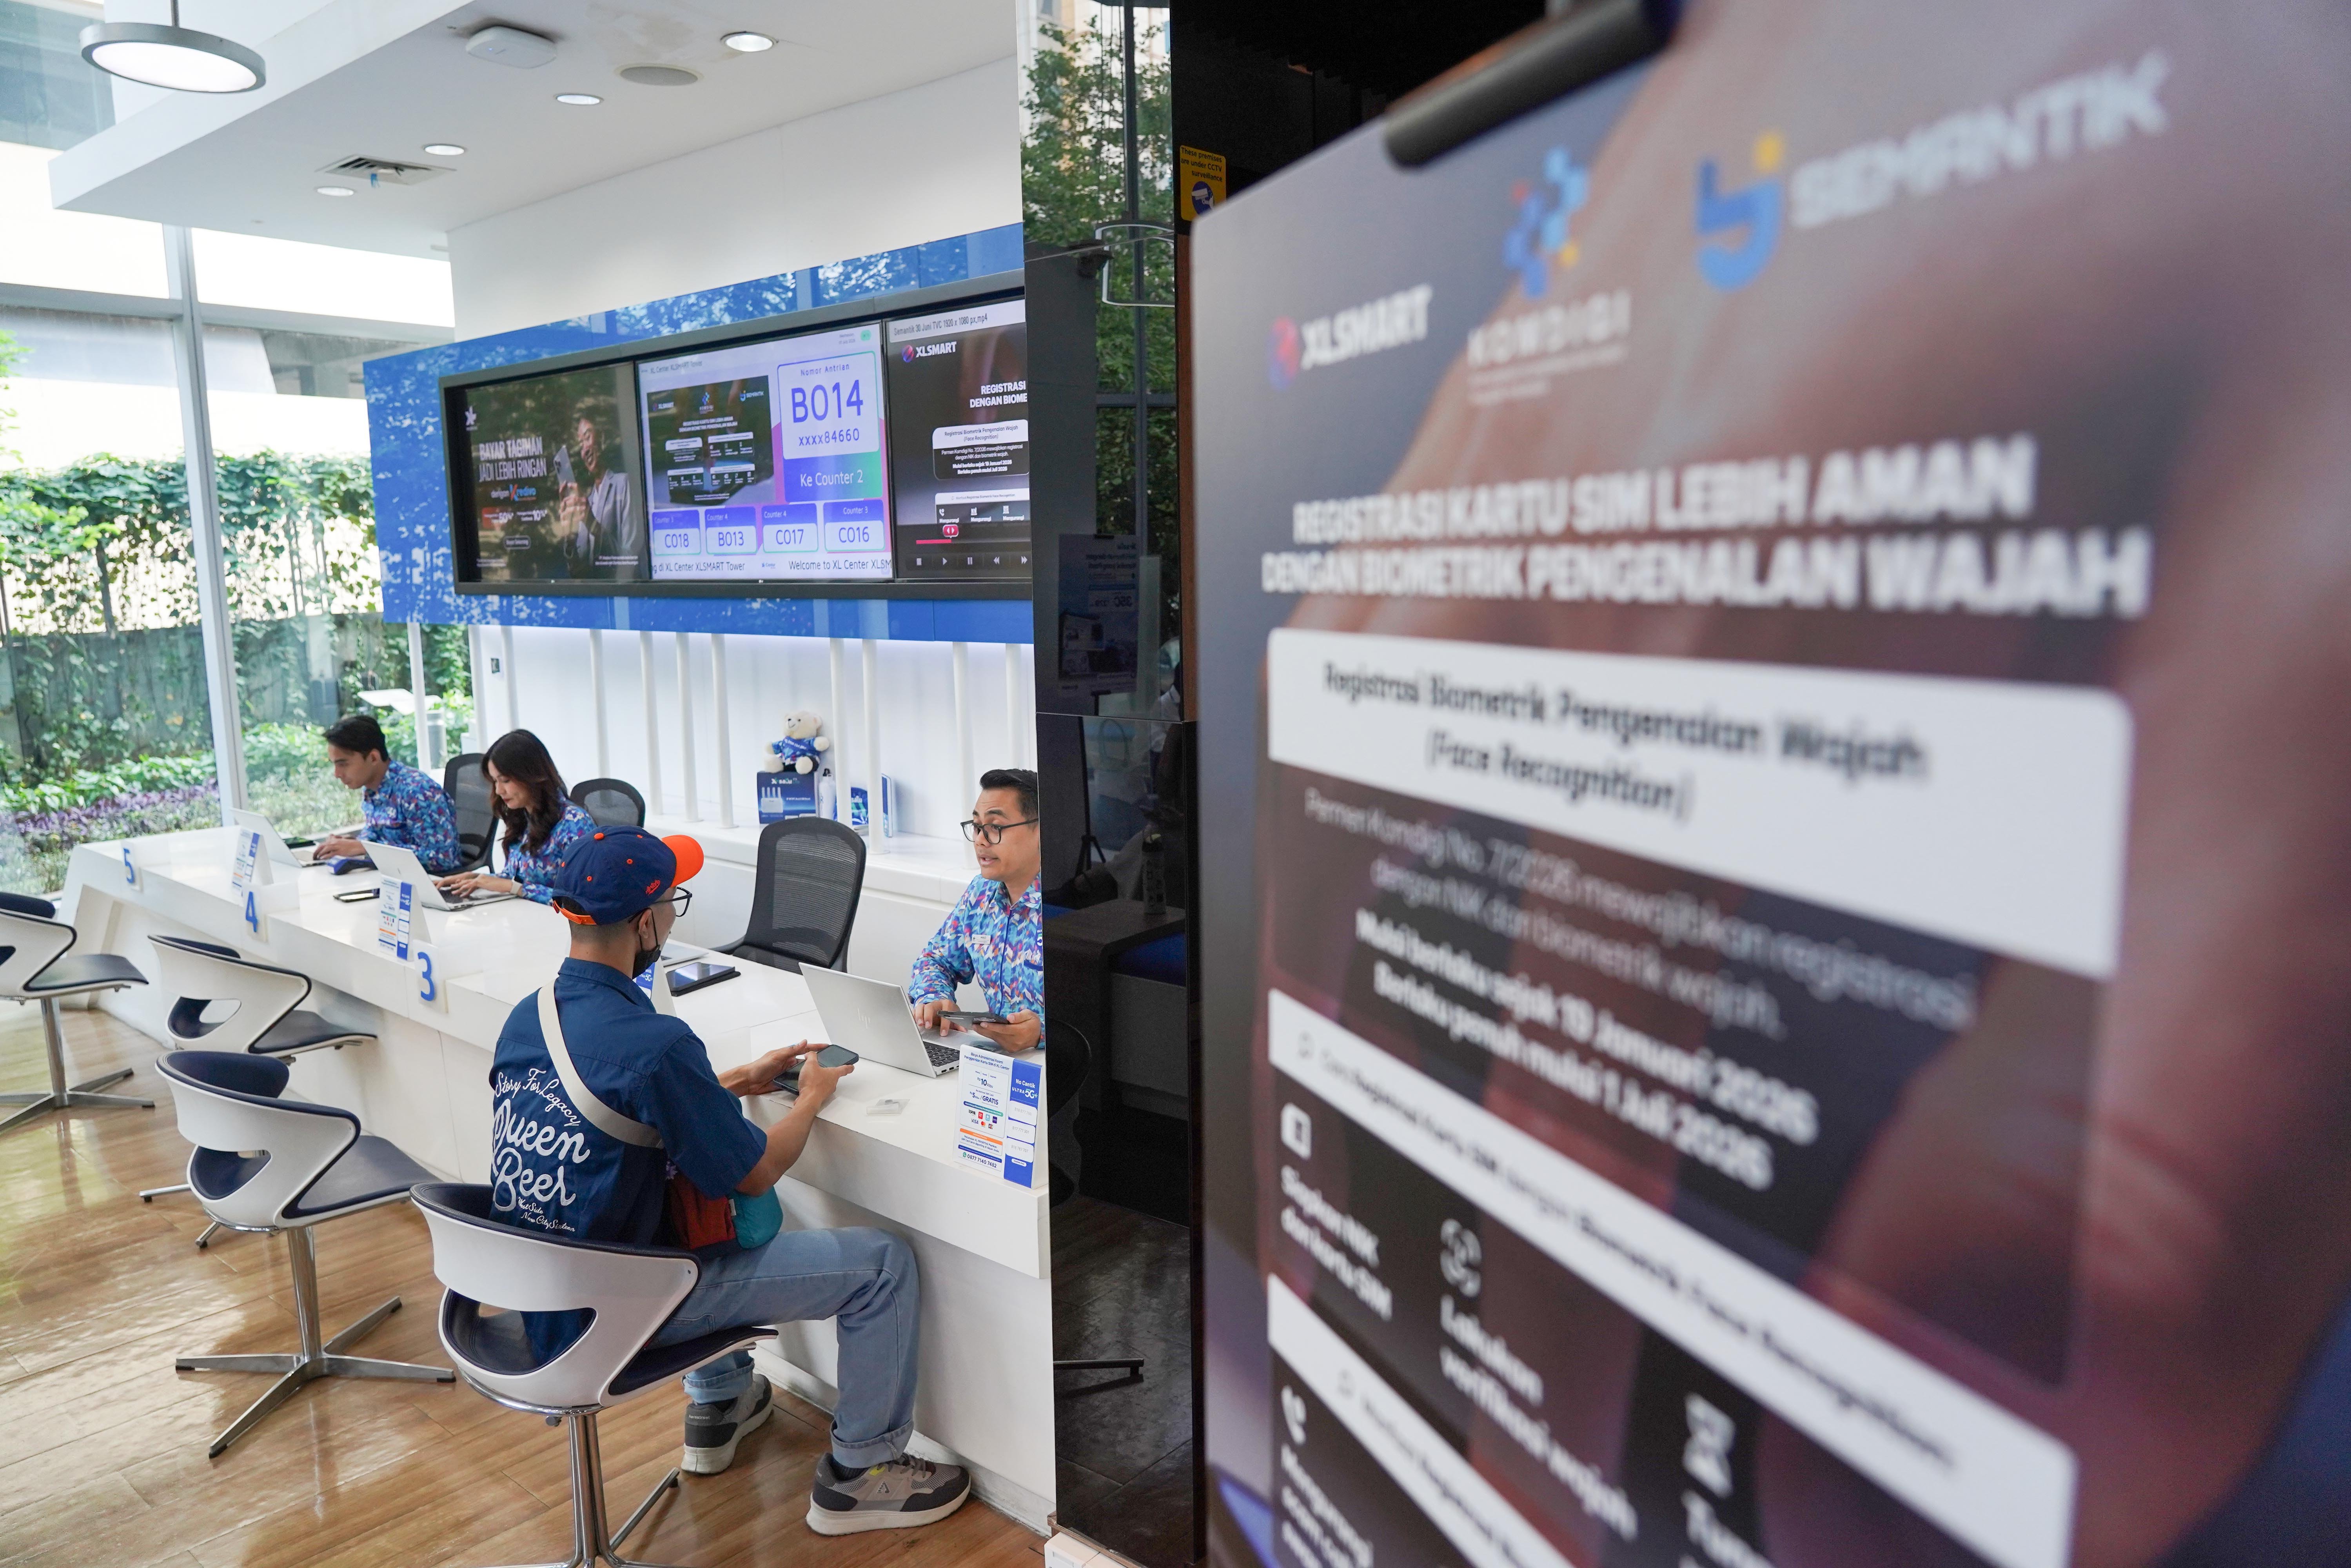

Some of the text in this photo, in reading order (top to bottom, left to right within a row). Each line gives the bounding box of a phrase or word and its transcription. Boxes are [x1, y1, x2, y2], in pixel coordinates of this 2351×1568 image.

[1181, 147, 1222, 163] These premises
[1191, 170, 1223, 182] surveillance
[1207, 163, 1222, 172] CCTV
[893, 325, 915, 336] Semantik
[915, 324, 921, 332] 30
[921, 322, 932, 332] Juni
[932, 321, 942, 330] TVC
[943, 319, 954, 328] 1920
[959, 316, 969, 326] 1080
[1299, 283, 1435, 370] XLSMART
[915, 341, 957, 358] XLSMART
[801, 363, 850, 376] Nomor Antrian
[980, 380, 1027, 396] REGISTRASI
[969, 392, 1028, 408] DENGAN BIOME
[799, 428, 860, 446] xxxx84660
[974, 433, 999, 441] Recognition)
[479, 436, 543, 461] BAYAR TAGIHAN
[479, 458, 547, 483] JADI LEBIH RINGAN
[800, 469, 864, 487] Ke Counter 2
[1292, 431, 2038, 546] REGISTRASI KARTU SIM LEBIH AMAN
[665, 563, 673, 572] XL
[674, 562, 694, 572] Center
[695, 562, 724, 571] XLSMART
[726, 561, 745, 571] Tower
[788, 560, 821, 570] Welcome
[823, 561, 831, 570] to
[832, 560, 842, 569] XL
[843, 559, 869, 569] Center
[1260, 525, 2154, 621] DENGAN BIOMETRIK PENGENALAN WAJAH
[1429, 674, 1548, 724] Biometrik
[123, 848, 135, 884] 5
[245, 891, 258, 933] 4
[417, 951, 435, 1002] 3
[1012, 1086, 1025, 1094] ULTRA
[1022, 1080, 1036, 1089] Cantik
[495, 1067, 582, 1127] Story For Legacy
[982, 1095, 998, 1105] GRATIS
[492, 1098, 590, 1178] Queen
[492, 1147, 576, 1212] Beer
[518, 1196, 544, 1214] West Side
[521, 1211, 576, 1233] New City Sixteen
